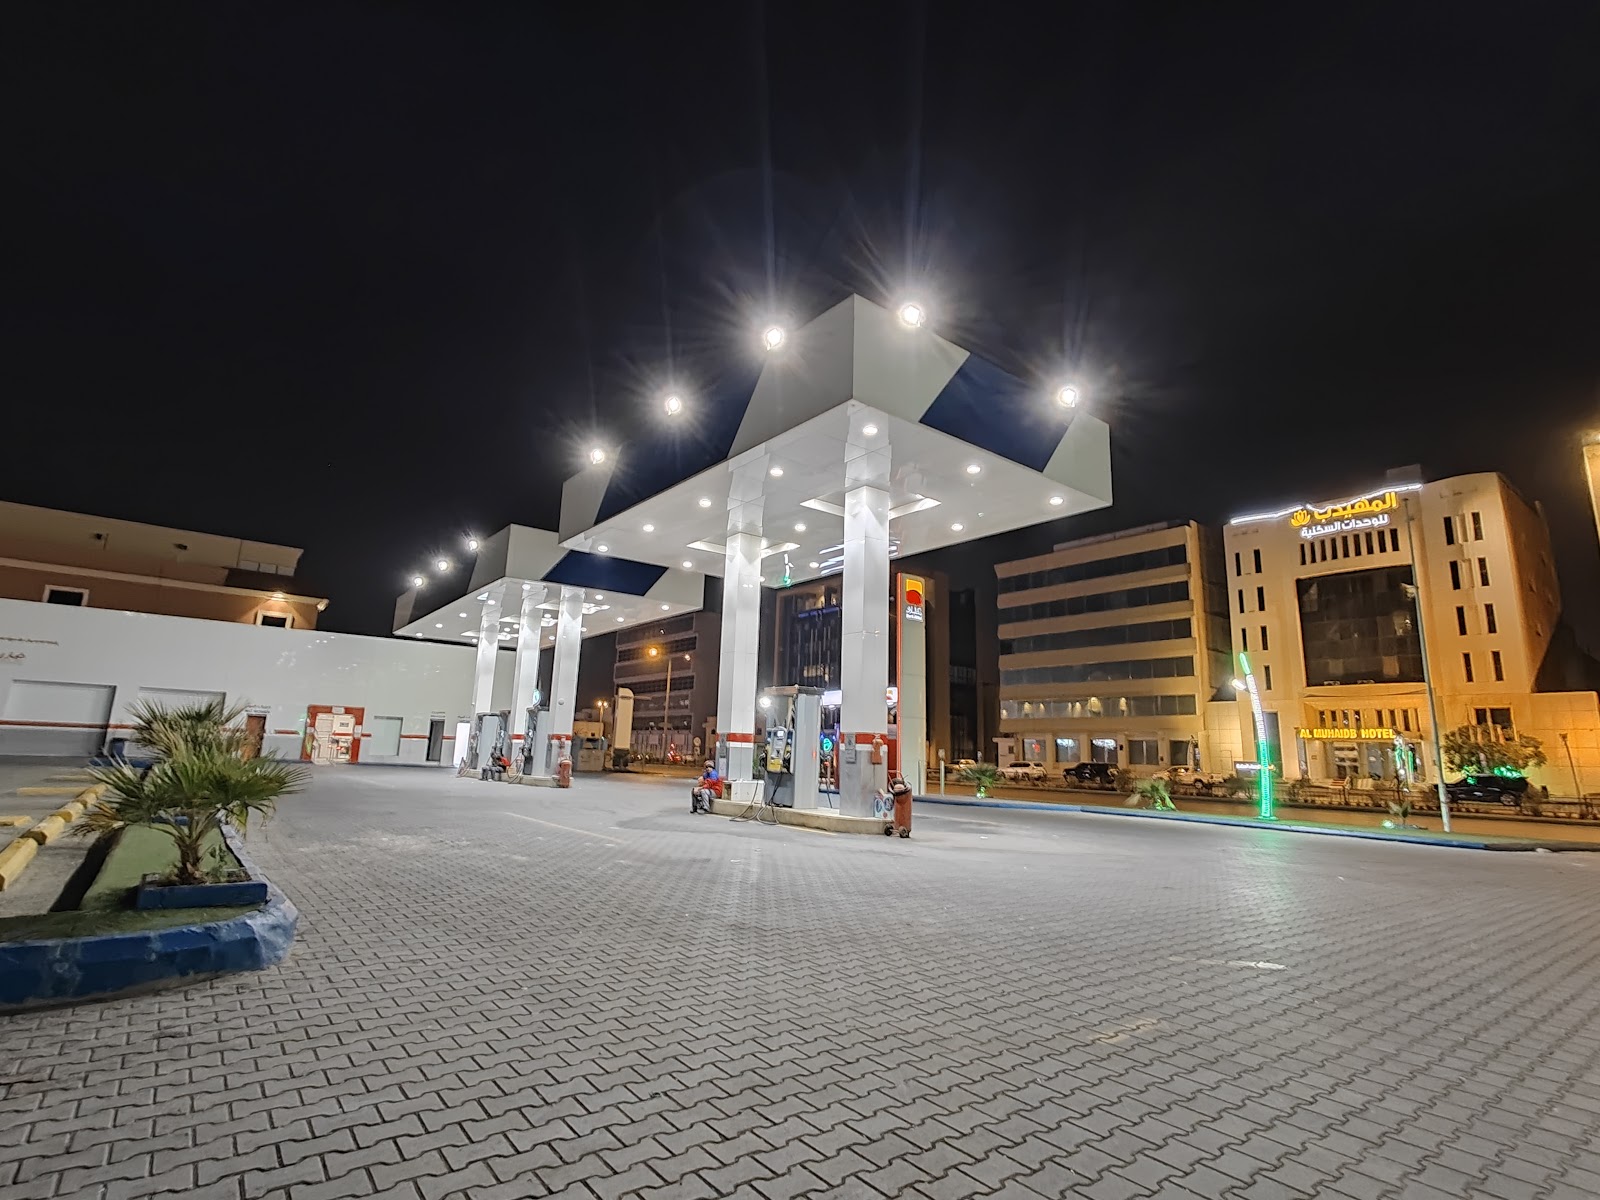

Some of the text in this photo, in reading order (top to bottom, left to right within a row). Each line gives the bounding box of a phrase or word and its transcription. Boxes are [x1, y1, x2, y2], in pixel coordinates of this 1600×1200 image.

[1314, 491, 1398, 523] المهيدب
[1301, 514, 1390, 538] للوحدات السكنية
[1300, 728, 1396, 739] AL MUHAIDB HOTEL
